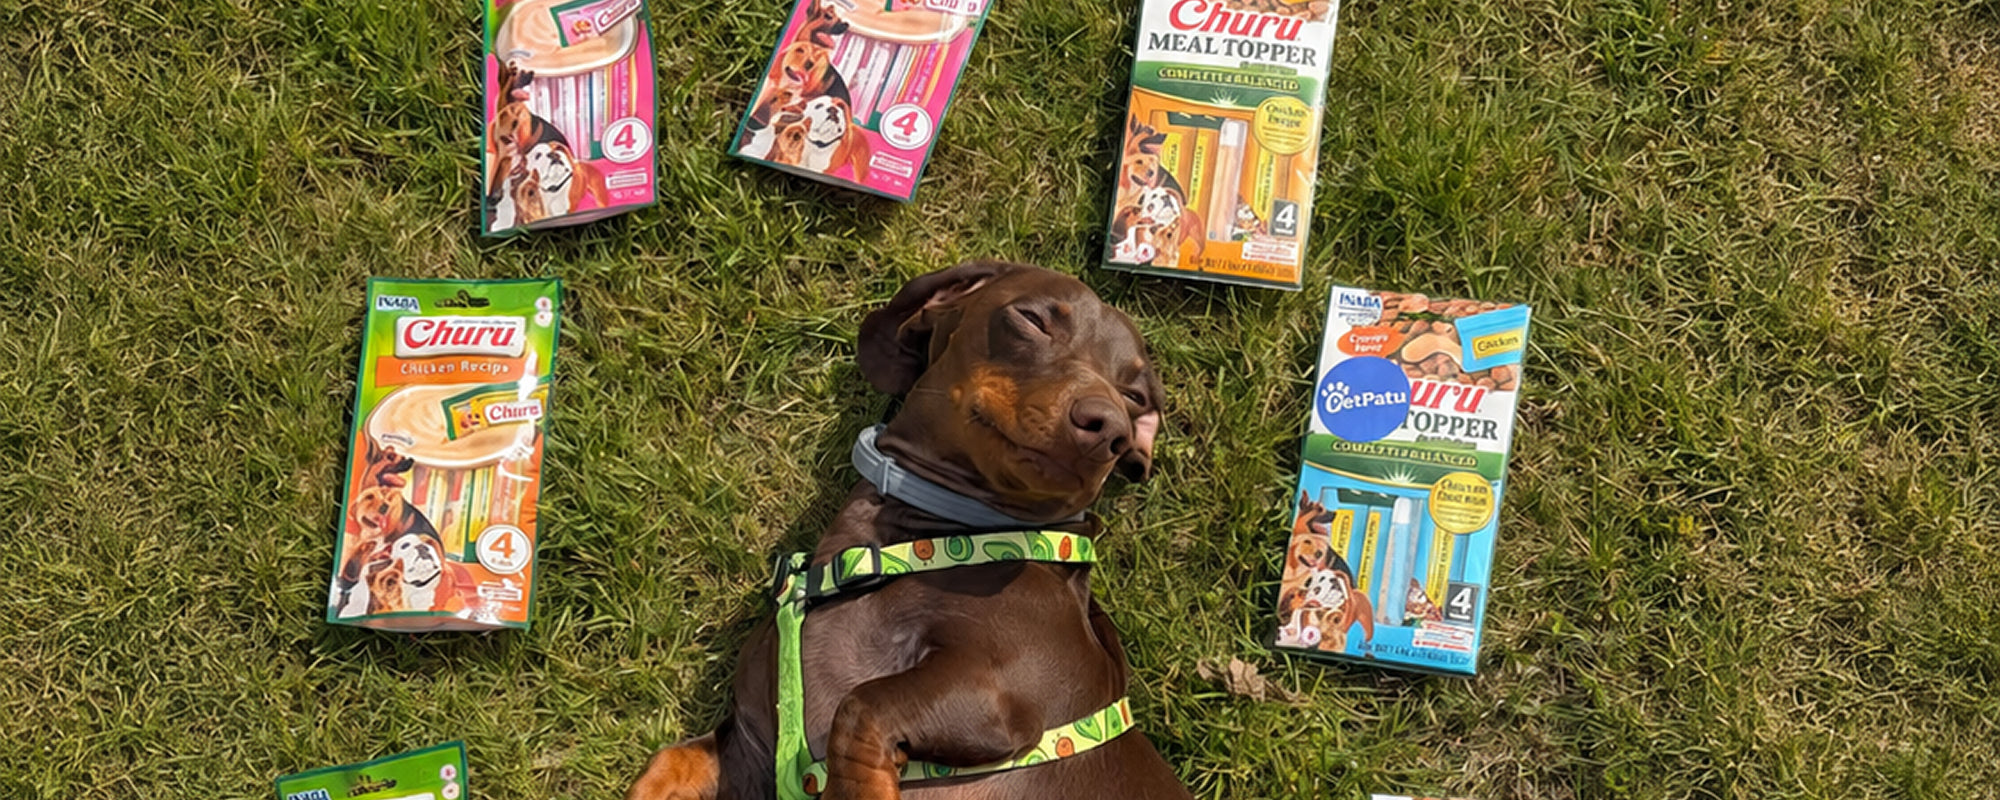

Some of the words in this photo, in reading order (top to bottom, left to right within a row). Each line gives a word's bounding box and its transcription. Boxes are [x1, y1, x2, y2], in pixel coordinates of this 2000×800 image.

[1169, 0, 1303, 41] Churu
[1148, 33, 1220, 54] MEAL
[1222, 39, 1317, 67] TOPPER
[613, 124, 637, 149] 4
[892, 111, 917, 136] 4
[1276, 204, 1295, 229] 4
[404, 319, 516, 349] Churu
[1410, 380, 1484, 414] uru
[1401, 411, 1498, 440] TOPPER
[489, 532, 516, 558] 4
[1450, 588, 1472, 613] 4
